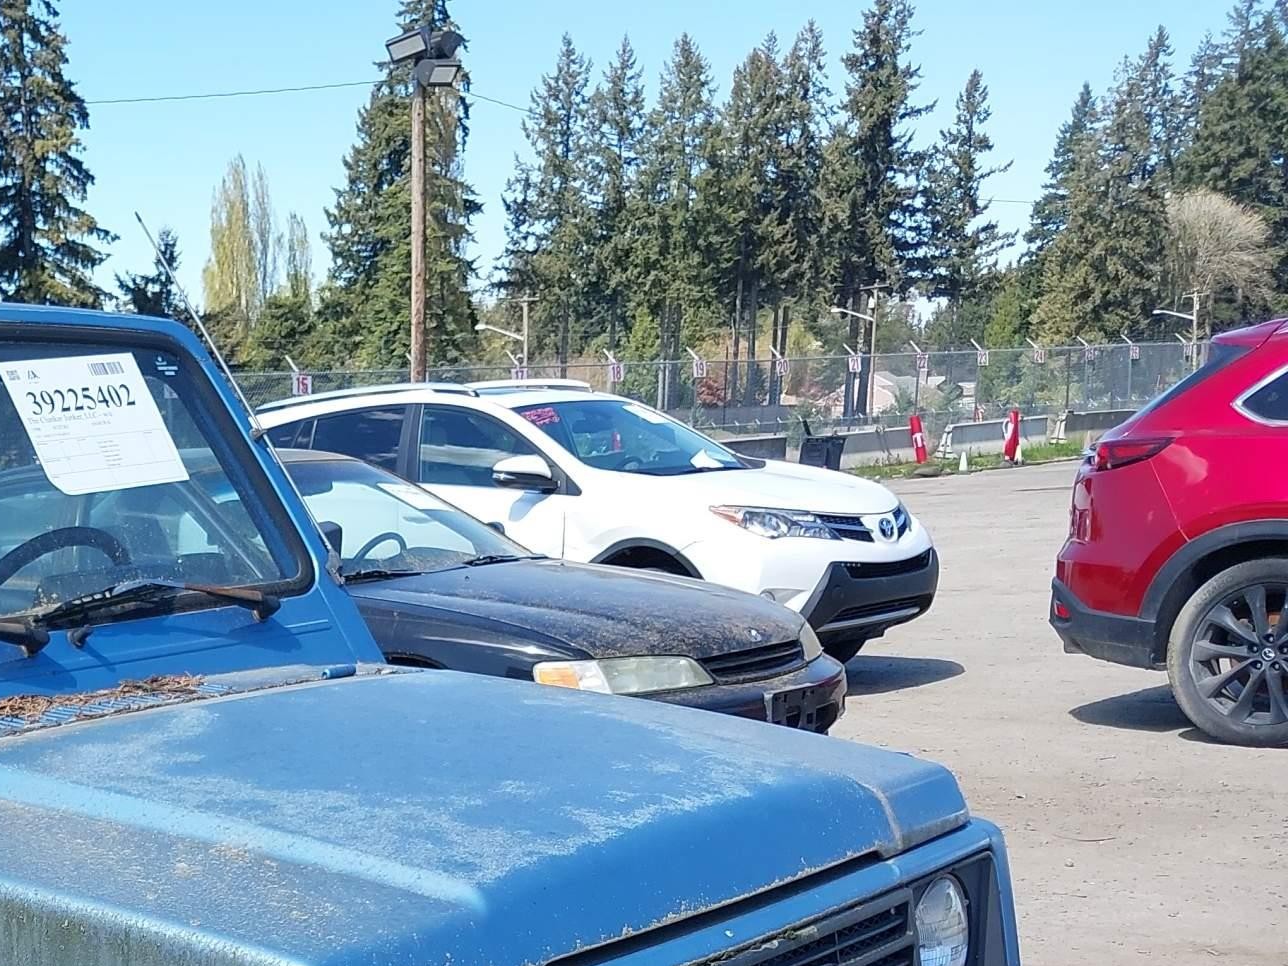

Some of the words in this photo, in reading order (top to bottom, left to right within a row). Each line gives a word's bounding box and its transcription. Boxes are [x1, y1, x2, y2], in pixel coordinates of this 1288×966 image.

[695, 362, 705, 376] 19
[777, 360, 789, 374] 20
[851, 358, 859, 371] 21
[612, 365, 622, 381] 18
[296, 377, 309, 394] 15
[25, 383, 136, 416] 39225402
